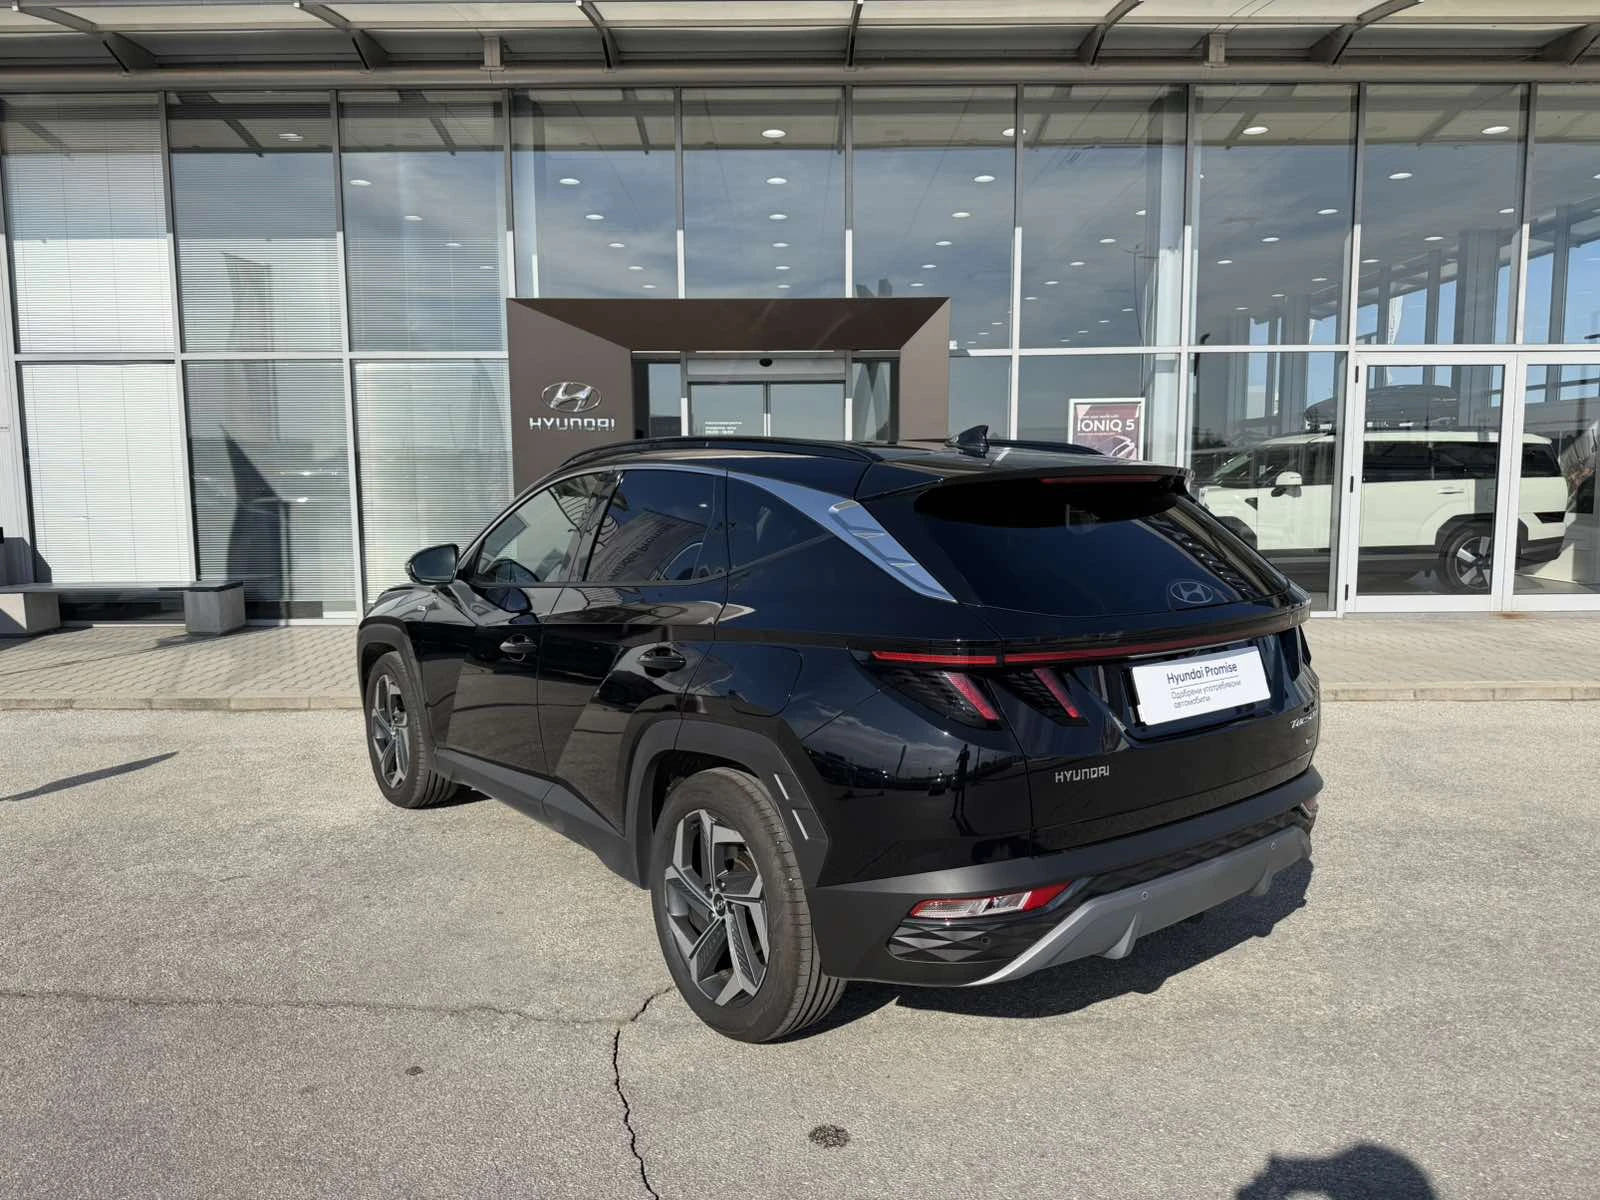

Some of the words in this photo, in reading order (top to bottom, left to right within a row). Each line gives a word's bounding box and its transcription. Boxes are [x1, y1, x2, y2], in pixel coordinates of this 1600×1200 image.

[528, 417, 616, 432] HYUNDAI
[1077, 418, 1122, 433] IONIQ
[1125, 419, 1135, 431] 5
[1166, 666, 1205, 685] Hyundai
[1204, 661, 1239, 677] Promise
[1055, 764, 1110, 783] HYUNDAI
